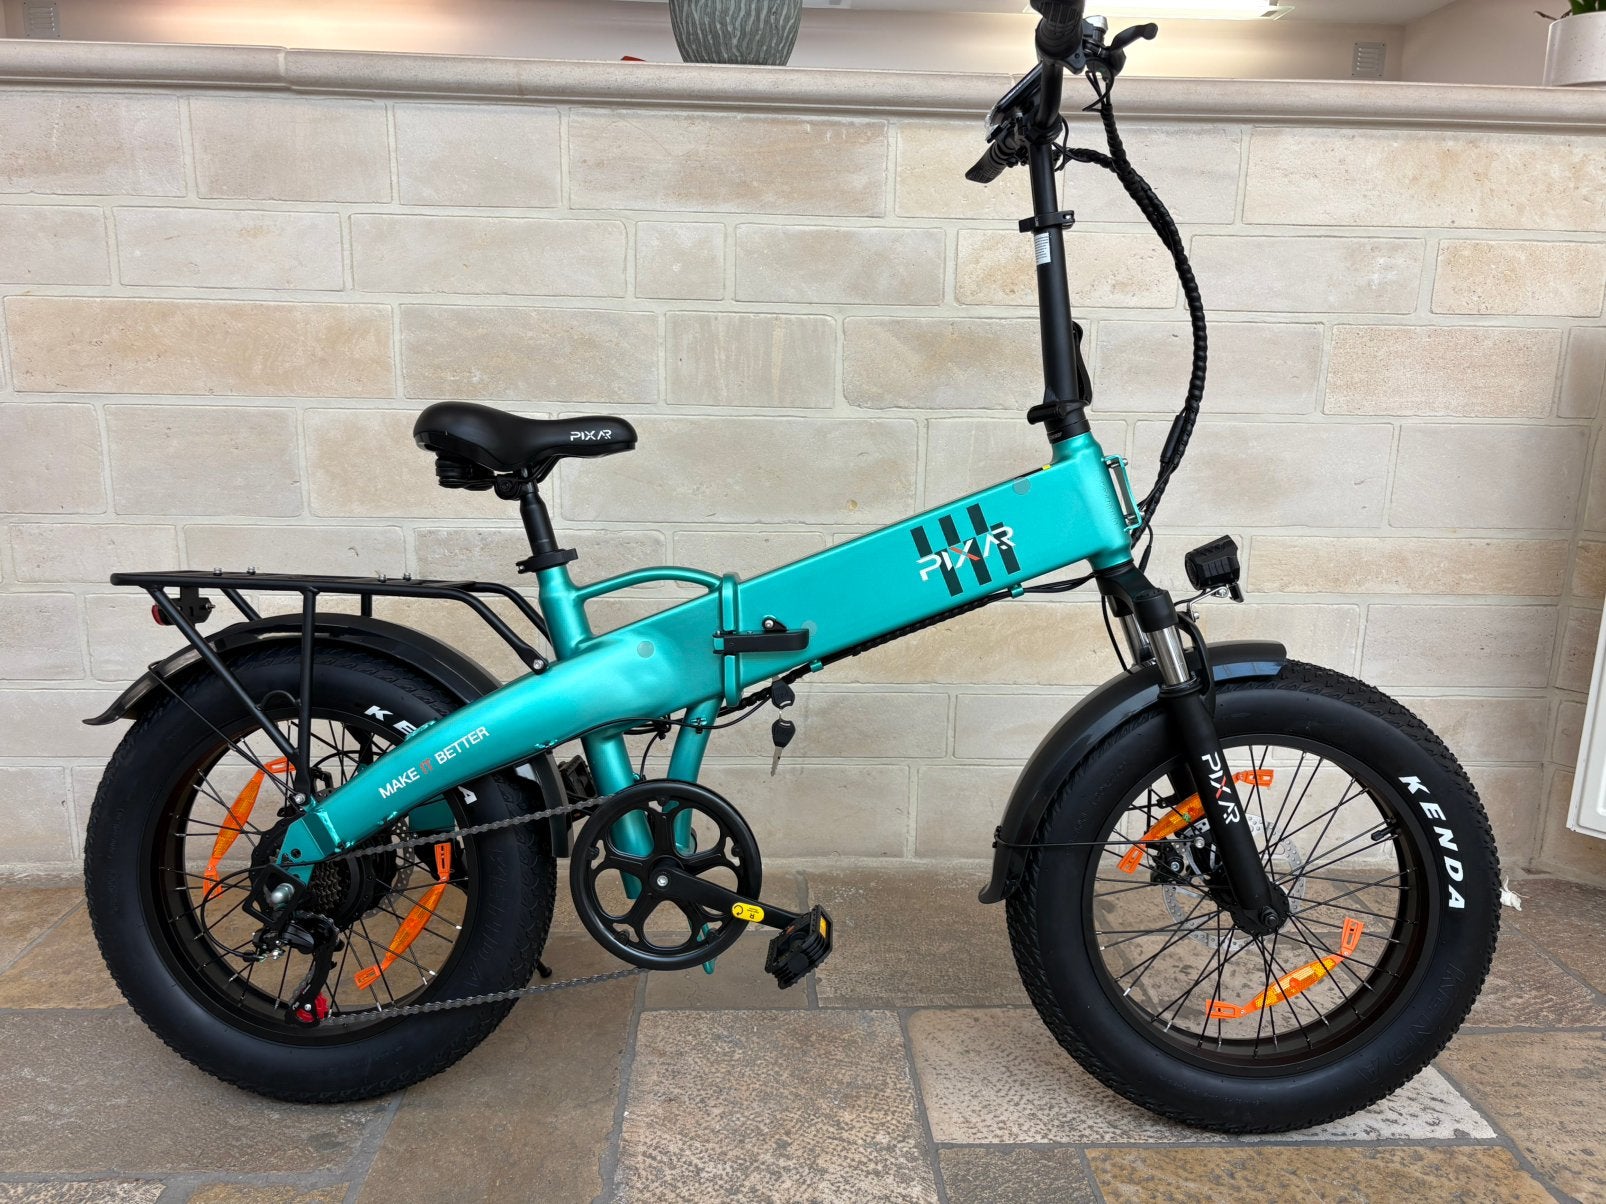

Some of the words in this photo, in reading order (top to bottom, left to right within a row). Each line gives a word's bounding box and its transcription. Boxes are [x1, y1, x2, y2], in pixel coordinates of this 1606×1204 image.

[570, 429, 612, 441] PIXAR
[916, 526, 1016, 582] PIXAR
[378, 767, 420, 799] MAKE
[419, 758, 434, 775] IT
[434, 726, 490, 764] BETTER
[1201, 751, 1240, 825] PIXAR
[1398, 775, 1465, 909] KENDA
